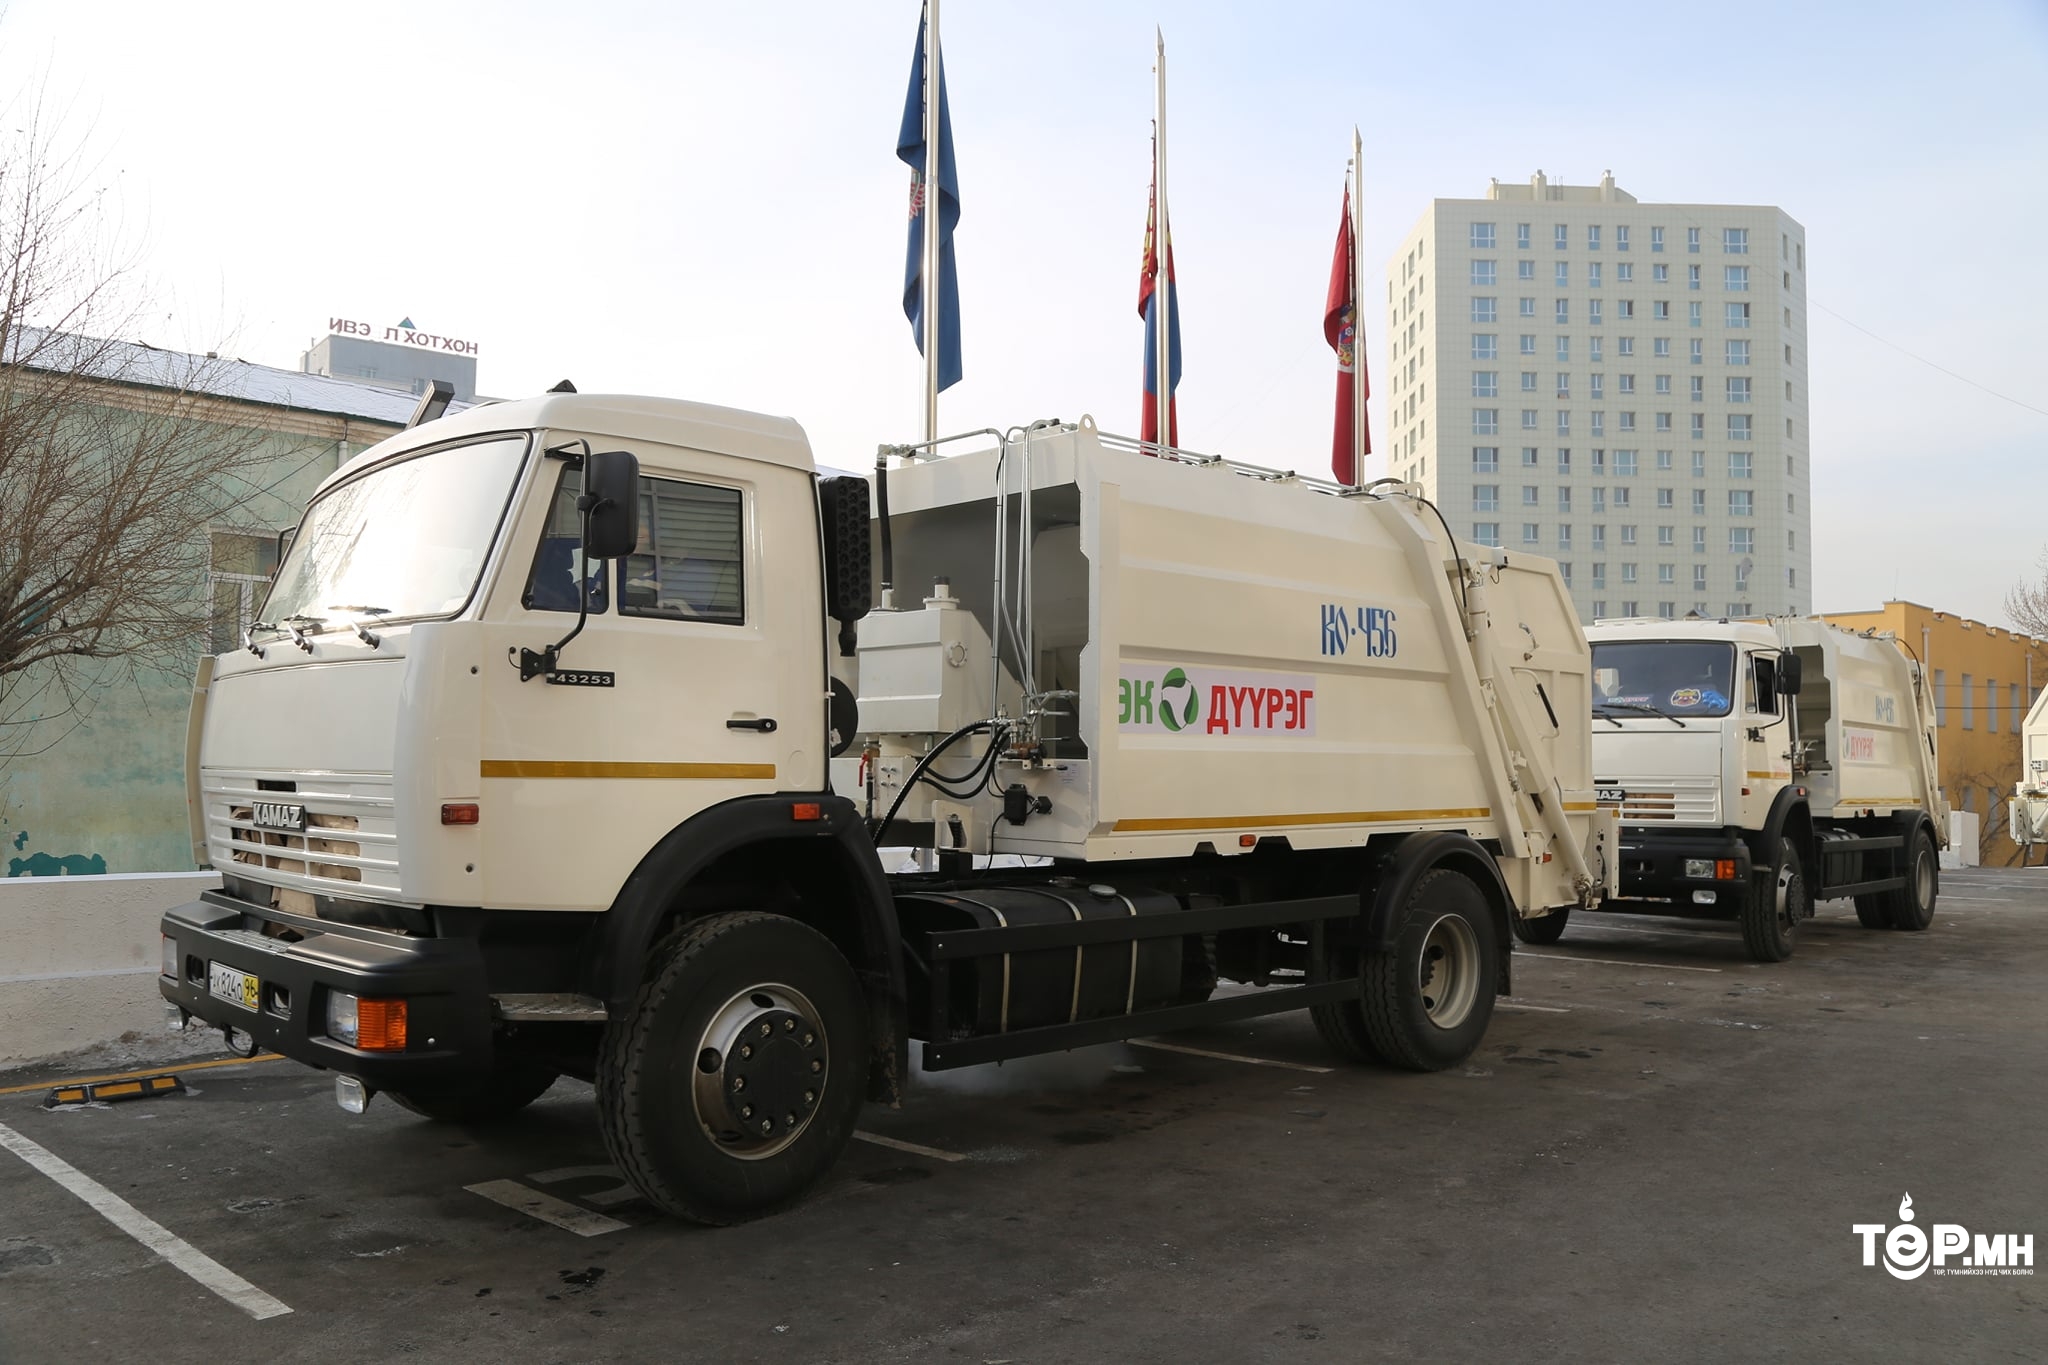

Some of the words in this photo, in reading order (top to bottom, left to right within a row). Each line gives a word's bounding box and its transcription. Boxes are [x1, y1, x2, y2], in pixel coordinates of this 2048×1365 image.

[404, 330, 478, 354] ХОТХОН
[557, 673, 611, 684] 43253
[253, 803, 302, 829] KAMAZ
